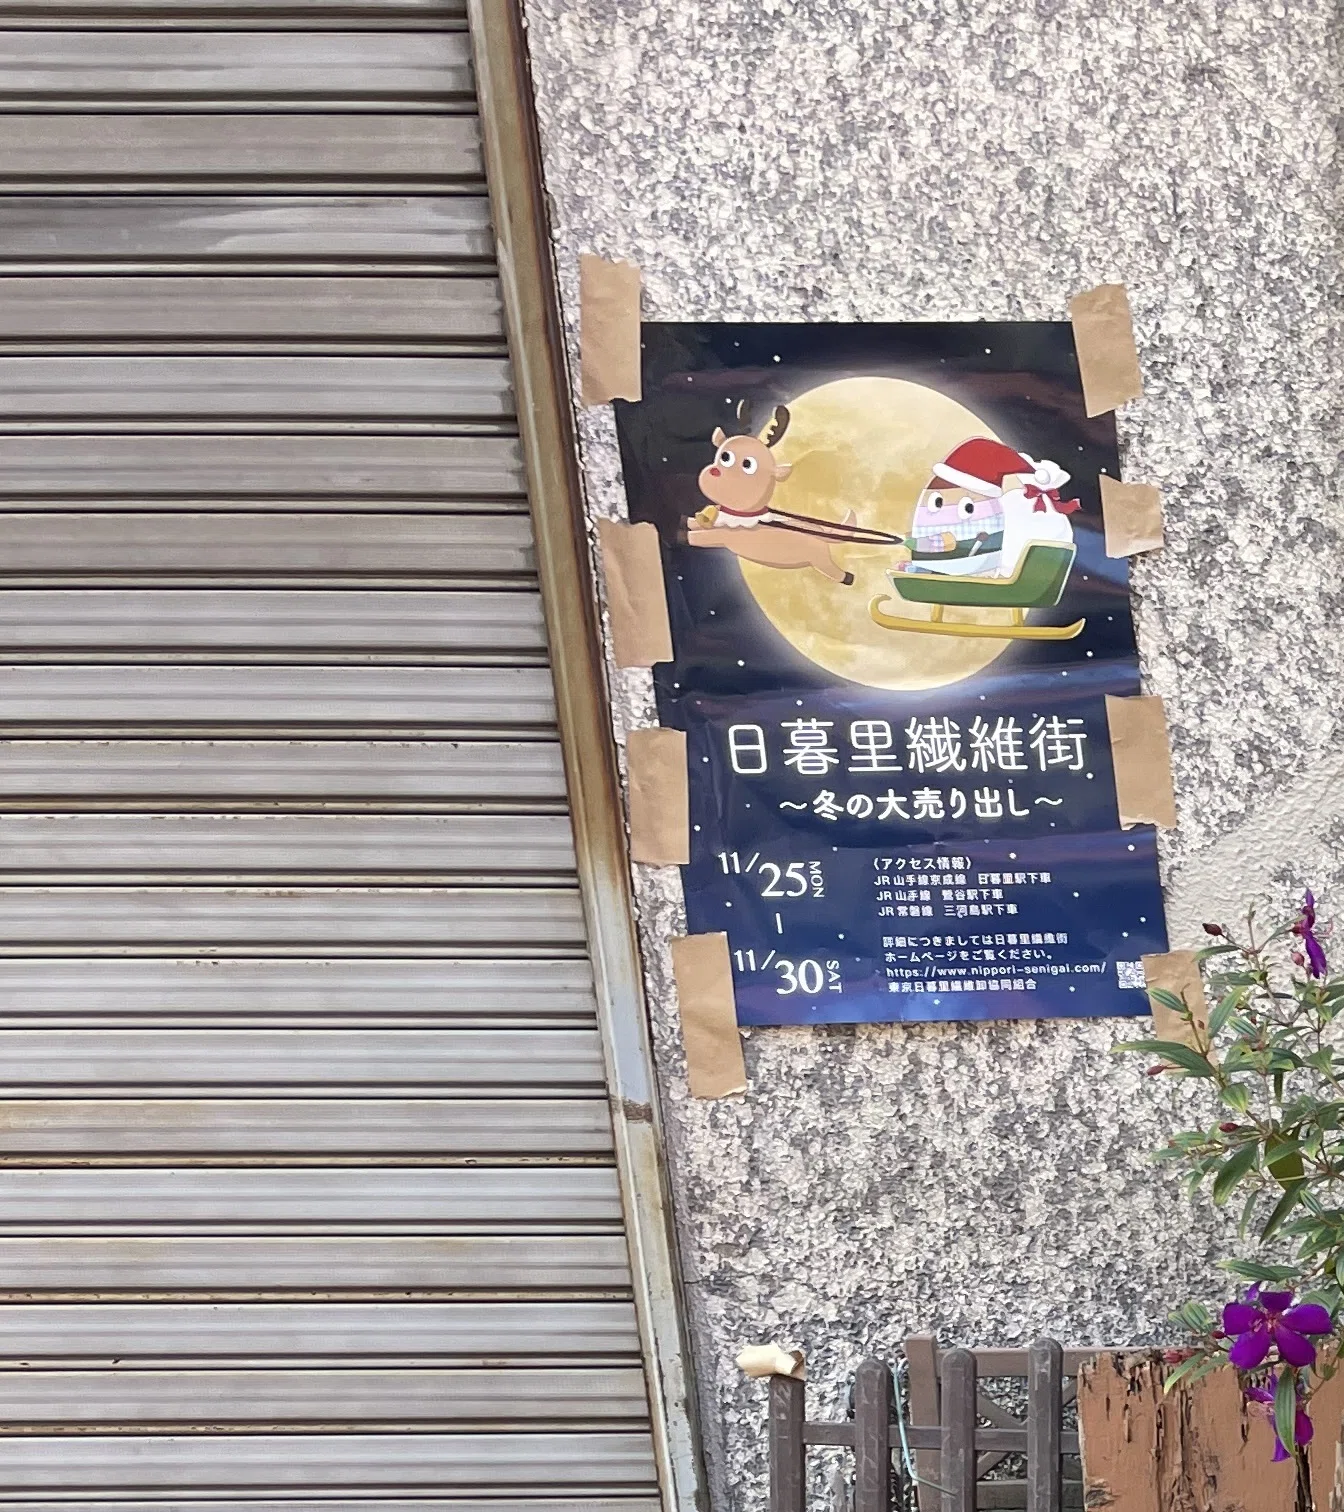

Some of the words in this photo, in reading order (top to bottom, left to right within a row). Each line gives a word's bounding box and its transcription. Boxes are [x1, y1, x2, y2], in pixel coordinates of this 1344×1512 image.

[728, 714, 1087, 776] 日暮里繊維街
[808, 860, 826, 898] MON
[826, 959, 844, 995] SAT
